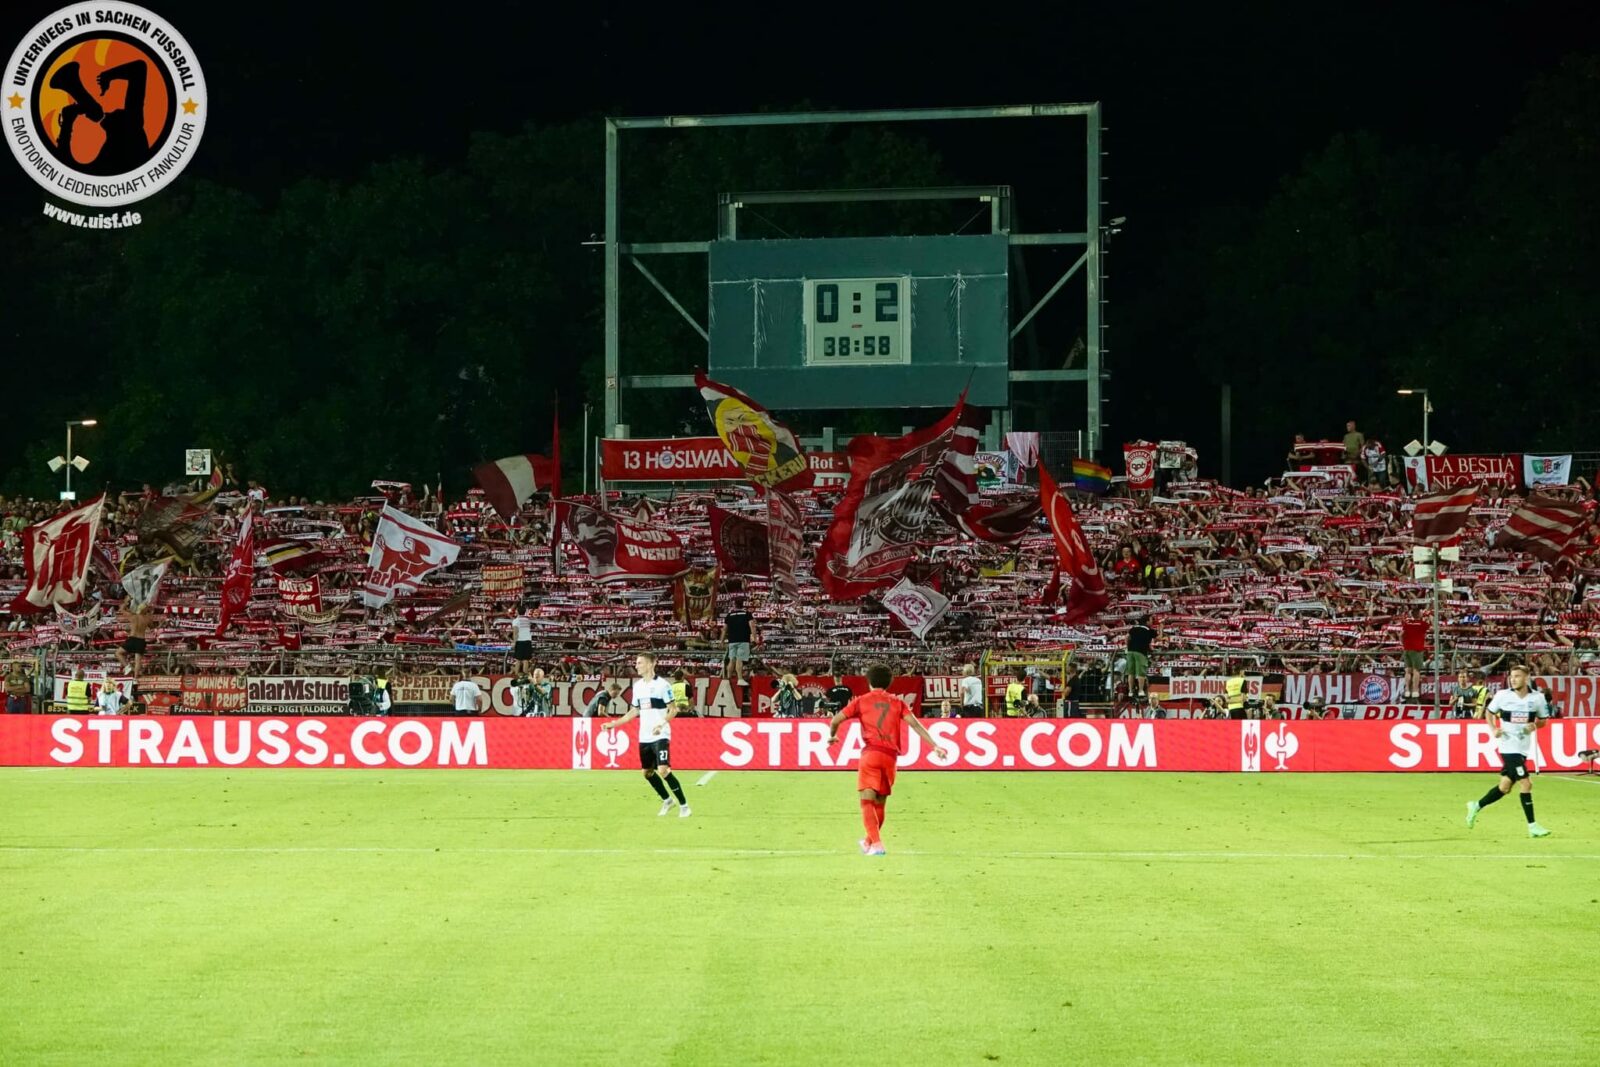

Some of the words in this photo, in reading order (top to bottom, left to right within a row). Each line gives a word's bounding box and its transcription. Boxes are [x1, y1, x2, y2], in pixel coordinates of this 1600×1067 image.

[824, 336, 890, 356] 38:58
[623, 451, 640, 469] 13
[810, 456, 833, 470] Rot
[1431, 458, 1454, 473] LA
[1458, 458, 1514, 473] BESTIA
[249, 680, 348, 701] alarMstufe
[402, 688, 424, 701] BEI
[1172, 680, 1196, 695] RED
[183, 692, 202, 707] RED
[216, 693, 246, 708] PRIDE
[278, 704, 344, 714] DIGITALDRUCK
[872, 703, 890, 732] 7
[49, 719, 489, 766] STRAUSS.COM
[659, 750, 668, 760] 27
